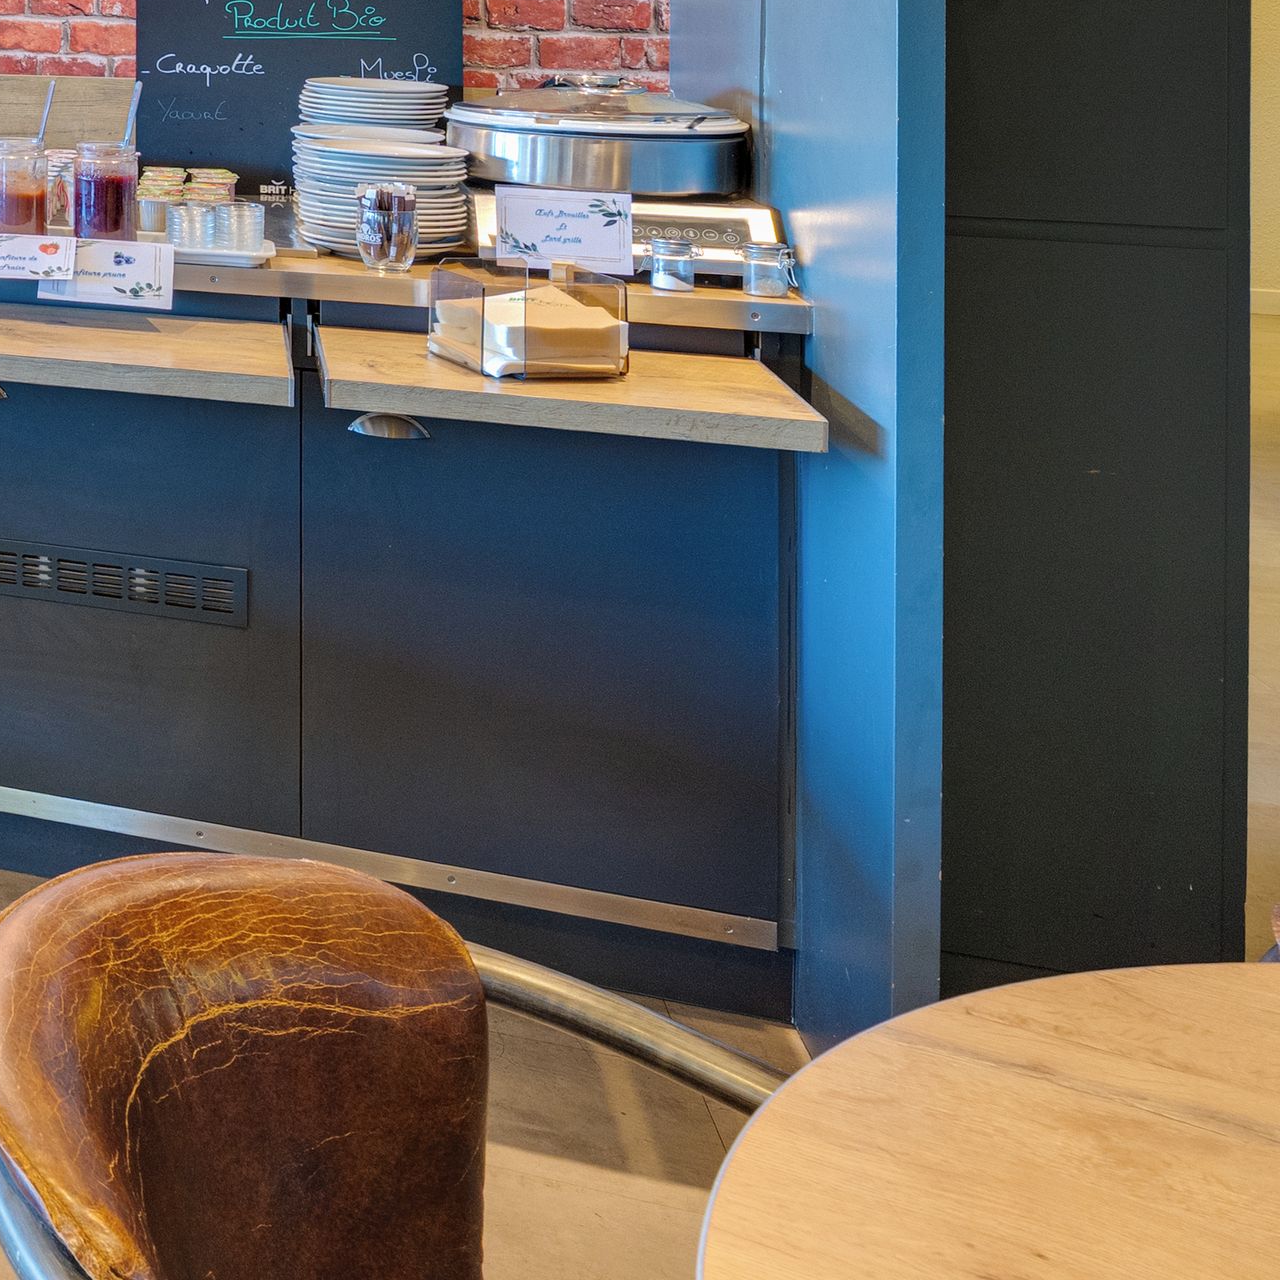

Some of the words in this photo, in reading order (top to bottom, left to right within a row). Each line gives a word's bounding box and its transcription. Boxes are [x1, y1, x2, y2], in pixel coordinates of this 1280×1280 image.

[225, 0, 320, 30] Produit
[156, 53, 265, 87] Craquotte
[360, 53, 437, 83] Muesli
[260, 184, 287, 194] BRIT
[101, 271, 126, 279] prune
